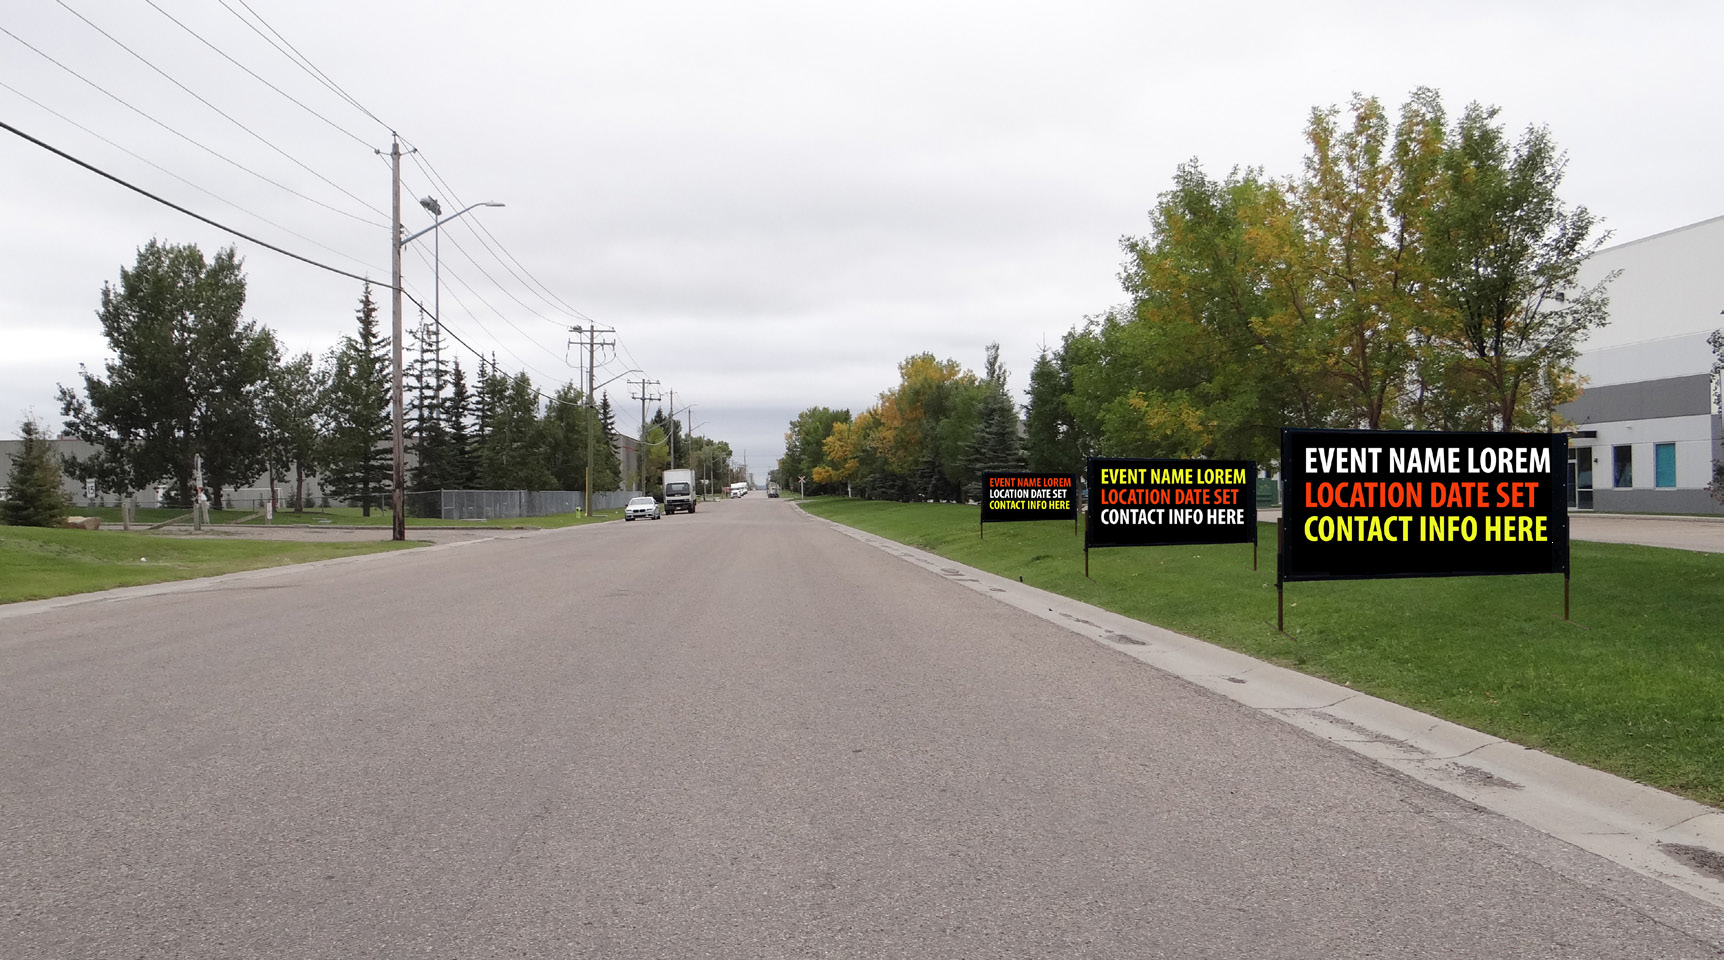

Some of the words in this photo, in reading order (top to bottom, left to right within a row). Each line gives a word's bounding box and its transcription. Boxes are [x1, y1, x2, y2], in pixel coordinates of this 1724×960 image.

[1306, 448, 1382, 473] EVENT
[1390, 448, 1460, 473] NAME
[1468, 447, 1550, 473] LOREM
[990, 478, 1015, 487] EVENT
[1018, 478, 1041, 487] NAME
[1044, 478, 1071, 487] LOREM
[1102, 469, 1147, 484] EVENT
[1151, 469, 1193, 484] NAME
[1197, 469, 1246, 484] LOREM
[990, 489, 1029, 498] LOCATION
[1031, 489, 1051, 498] DATE
[1053, 489, 1067, 498] SET
[1102, 489, 1170, 504] LOCATION
[1175, 489, 1210, 504] DATE
[1214, 489, 1239, 504] SET
[1306, 482, 1422, 507] LOCATION
[1431, 482, 1489, 507] DATE
[1497, 482, 1539, 507] SET
[990, 501, 1025, 509] CONTACT
[1028, 501, 1047, 509] INFO
[1049, 501, 1070, 509] HERE
[1101, 509, 1165, 524] CONTACT
[1169, 509, 1203, 524] INFO
[1207, 509, 1244, 524] HERE
[1305, 516, 1413, 541] CONTACT
[1420, 516, 1477, 541] INFO
[1486, 516, 1547, 541] HERE
